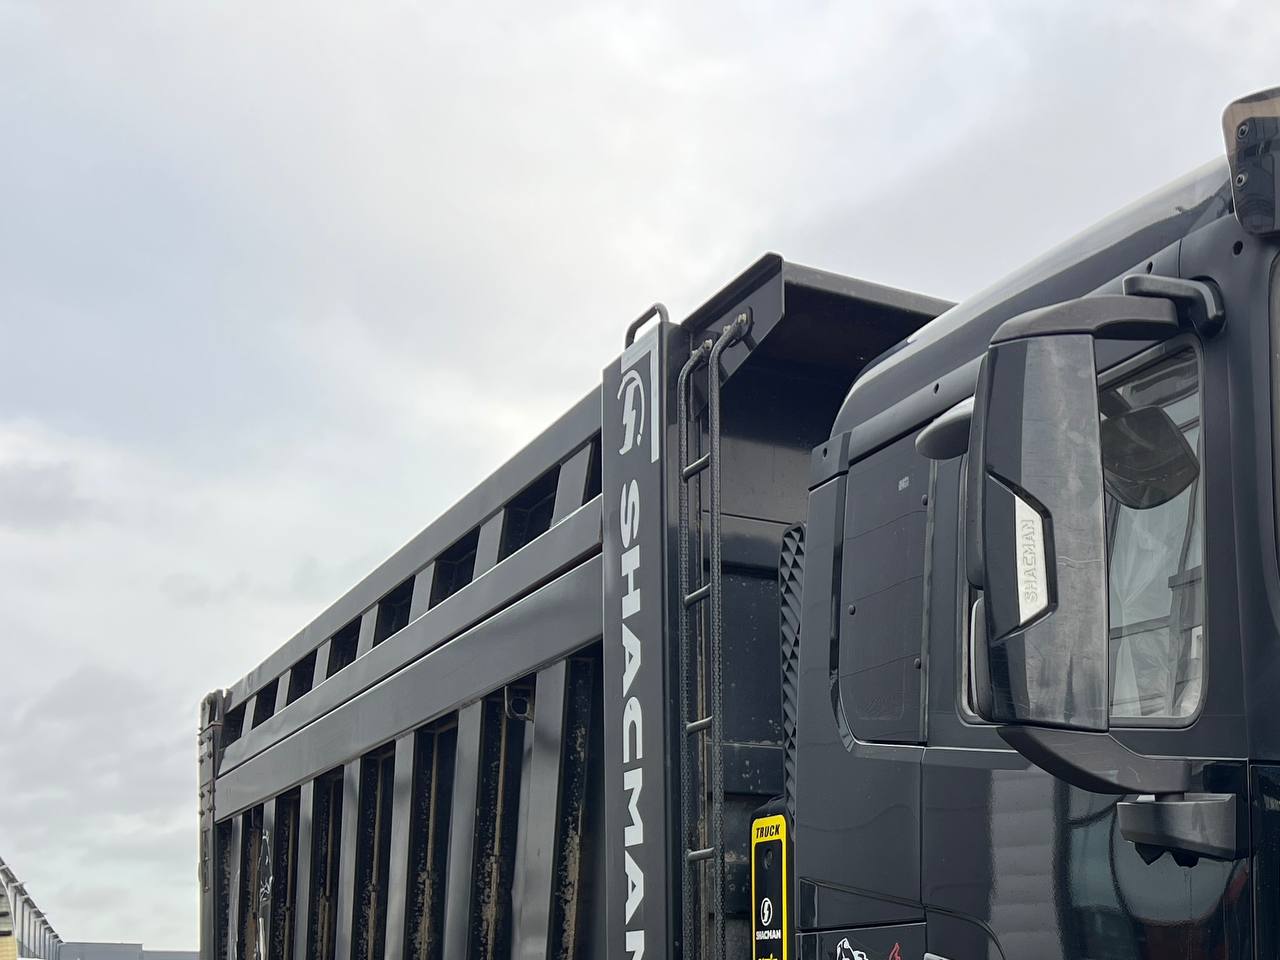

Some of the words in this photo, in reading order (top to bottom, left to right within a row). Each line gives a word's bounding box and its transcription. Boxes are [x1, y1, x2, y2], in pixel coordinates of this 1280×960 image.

[1020, 519, 1038, 602] SHACMAN
[755, 824, 780, 839] TRUCK
[755, 928, 781, 940] SHACMAN
